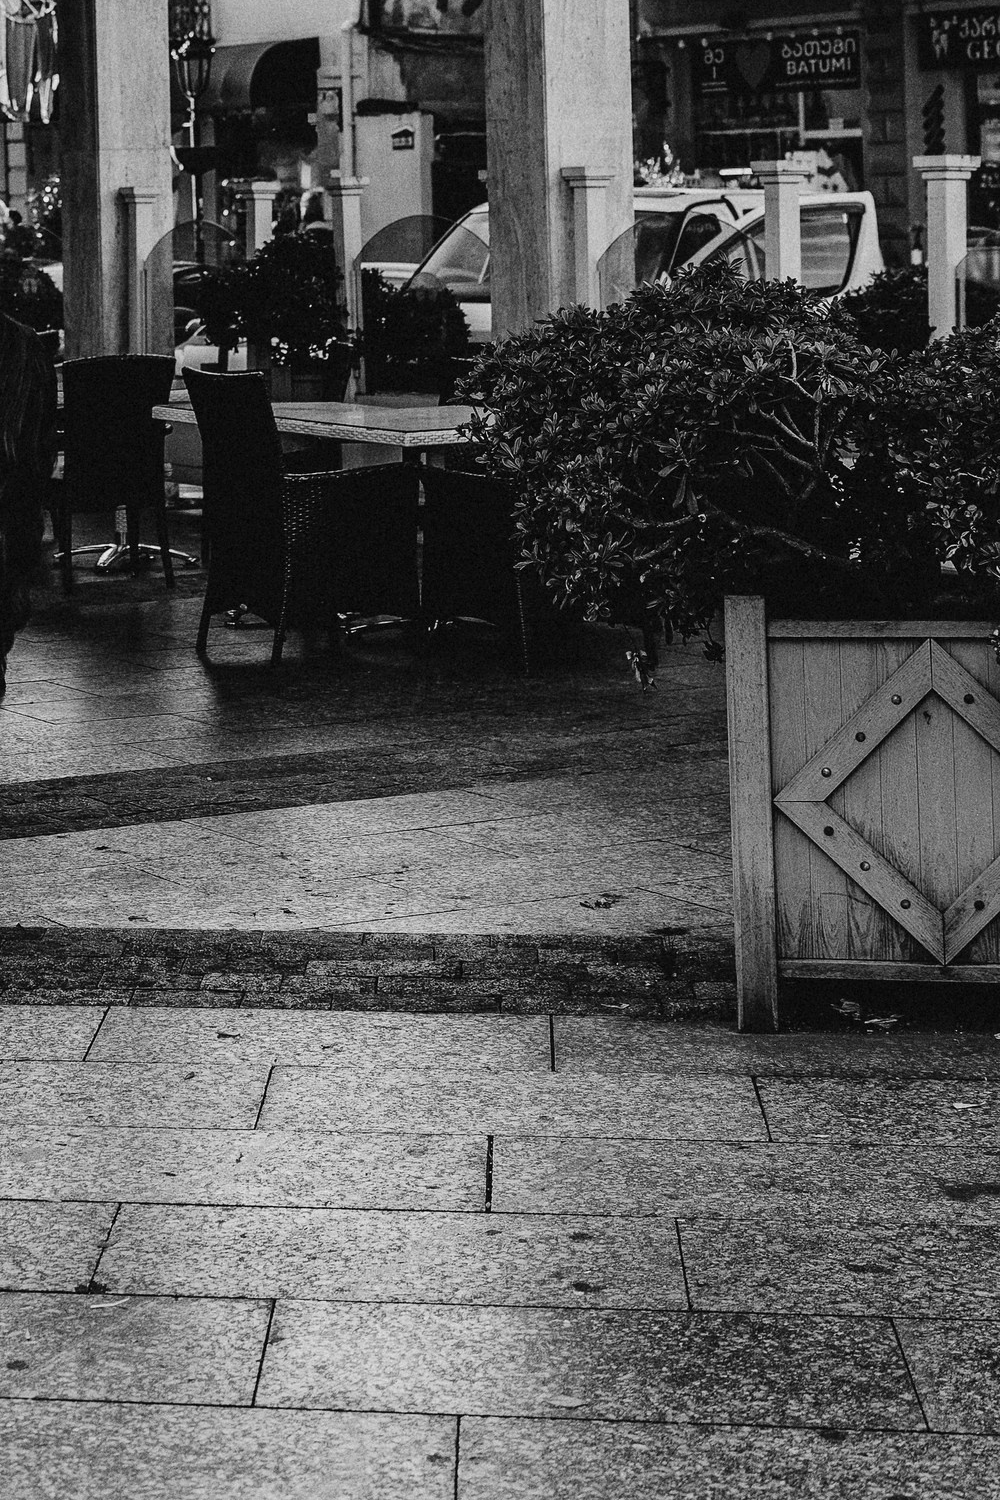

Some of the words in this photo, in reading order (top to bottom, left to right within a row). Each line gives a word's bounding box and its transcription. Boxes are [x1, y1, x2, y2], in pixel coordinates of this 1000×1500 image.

[959, 15, 1000, 38] ქარ
[781, 38, 856, 59] ბათუმი
[786, 57, 851, 75] BATUMI
